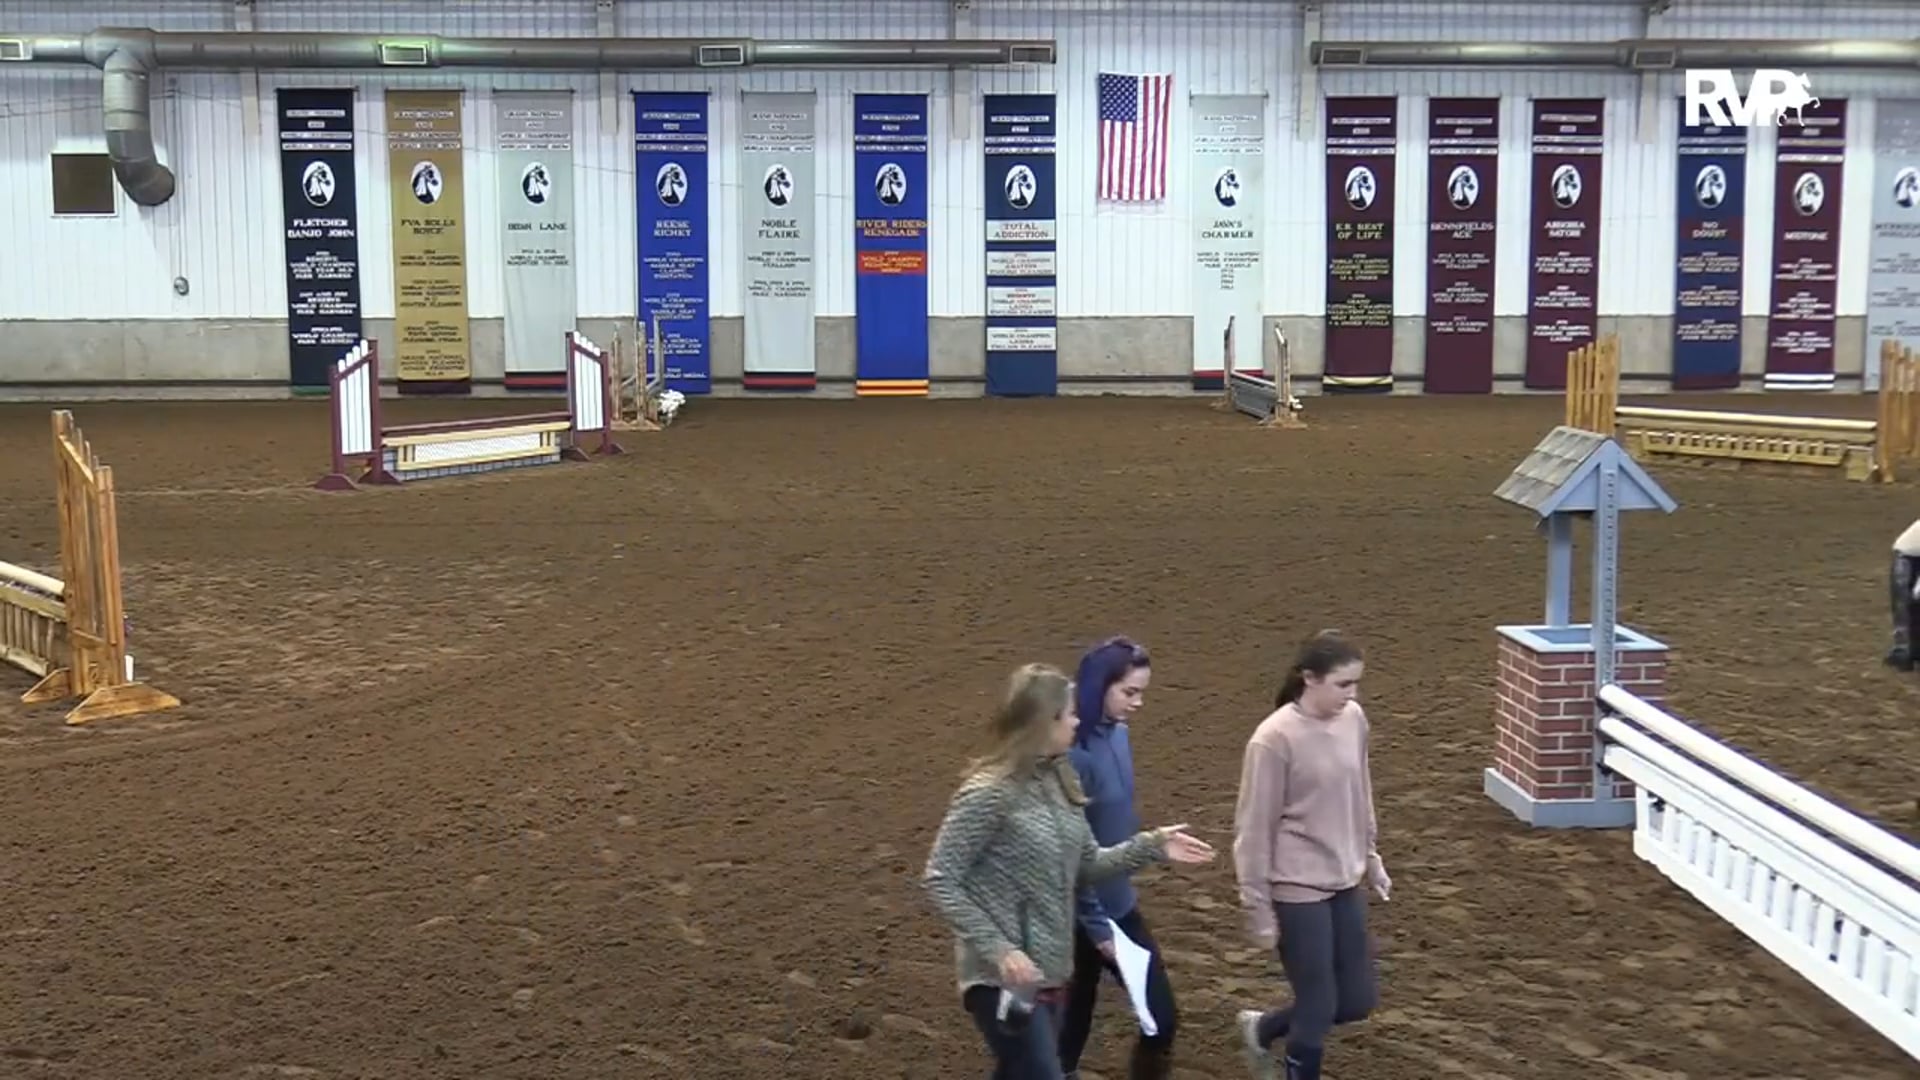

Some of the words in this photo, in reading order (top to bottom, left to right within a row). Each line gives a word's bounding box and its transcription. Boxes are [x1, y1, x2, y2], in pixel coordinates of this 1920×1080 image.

[761, 219, 797, 228] NOBLE
[1004, 222, 1039, 230] TOTAL
[758, 228, 800, 238] FLAIRE
[994, 230, 1049, 239] ADDICTION
[1201, 230, 1254, 239] CHARMER
